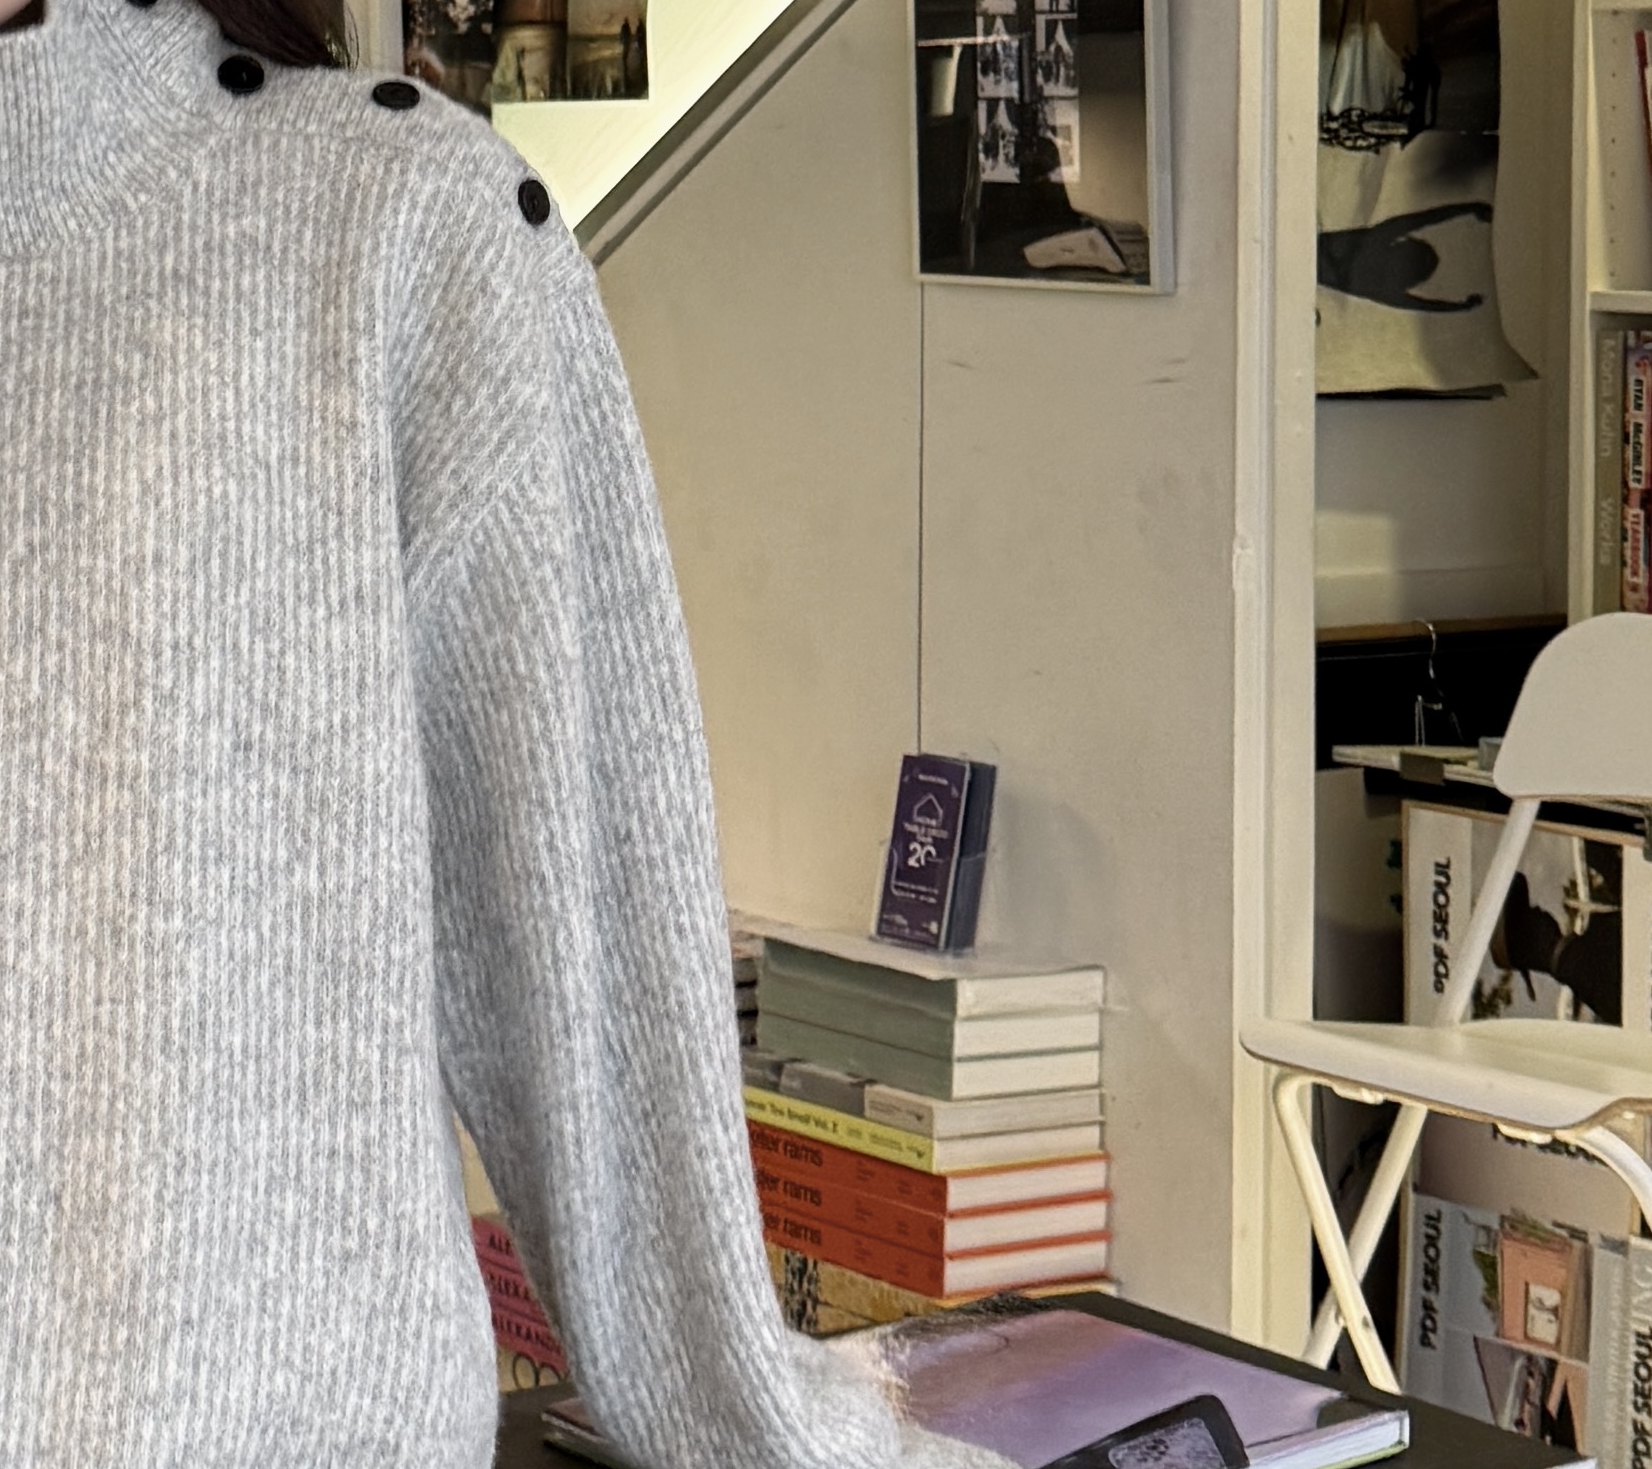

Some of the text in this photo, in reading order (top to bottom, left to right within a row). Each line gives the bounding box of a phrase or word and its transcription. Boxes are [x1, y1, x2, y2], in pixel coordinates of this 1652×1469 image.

[1432, 855, 1452, 941] SEOUL
[1419, 1208, 1443, 1351] PDF SEOUL
